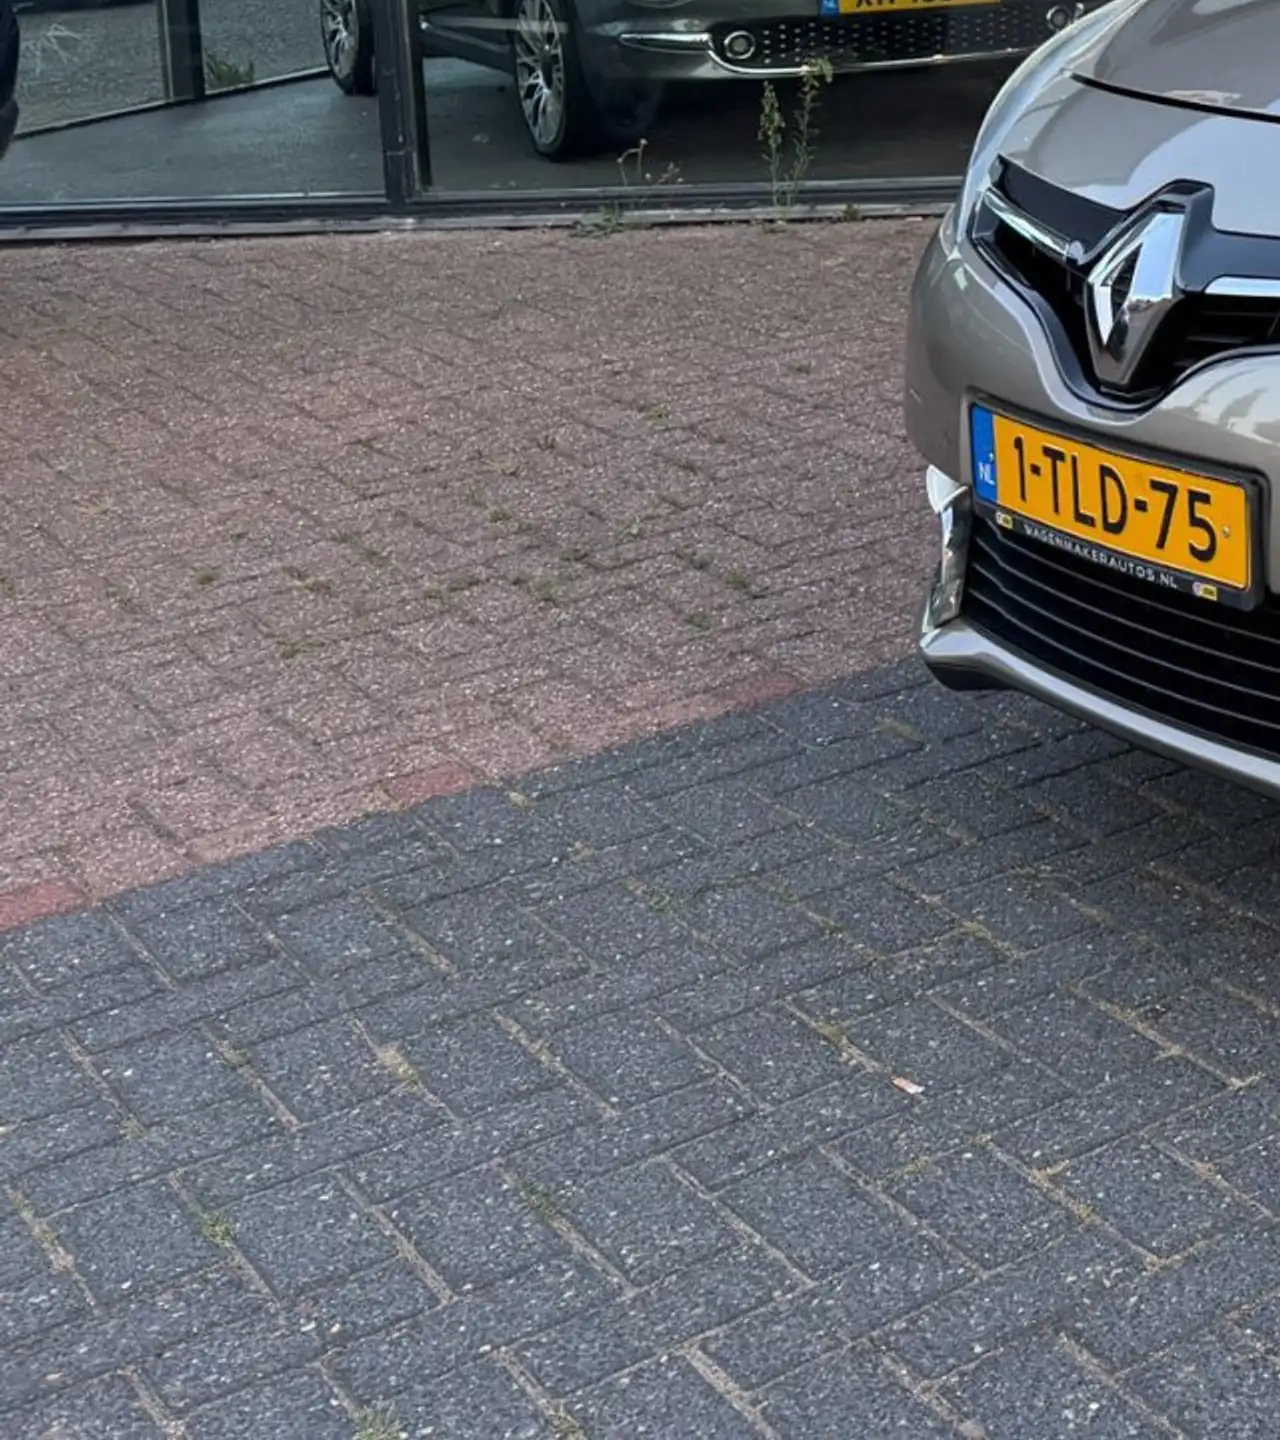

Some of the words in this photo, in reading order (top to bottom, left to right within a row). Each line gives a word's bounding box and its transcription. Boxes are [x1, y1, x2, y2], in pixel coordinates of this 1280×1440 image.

[978, 461, 997, 487] NL
[1013, 434, 1218, 563] 1-TLD-75
[1022, 522, 1179, 589] WAGENMAKERAUTOS.NL
